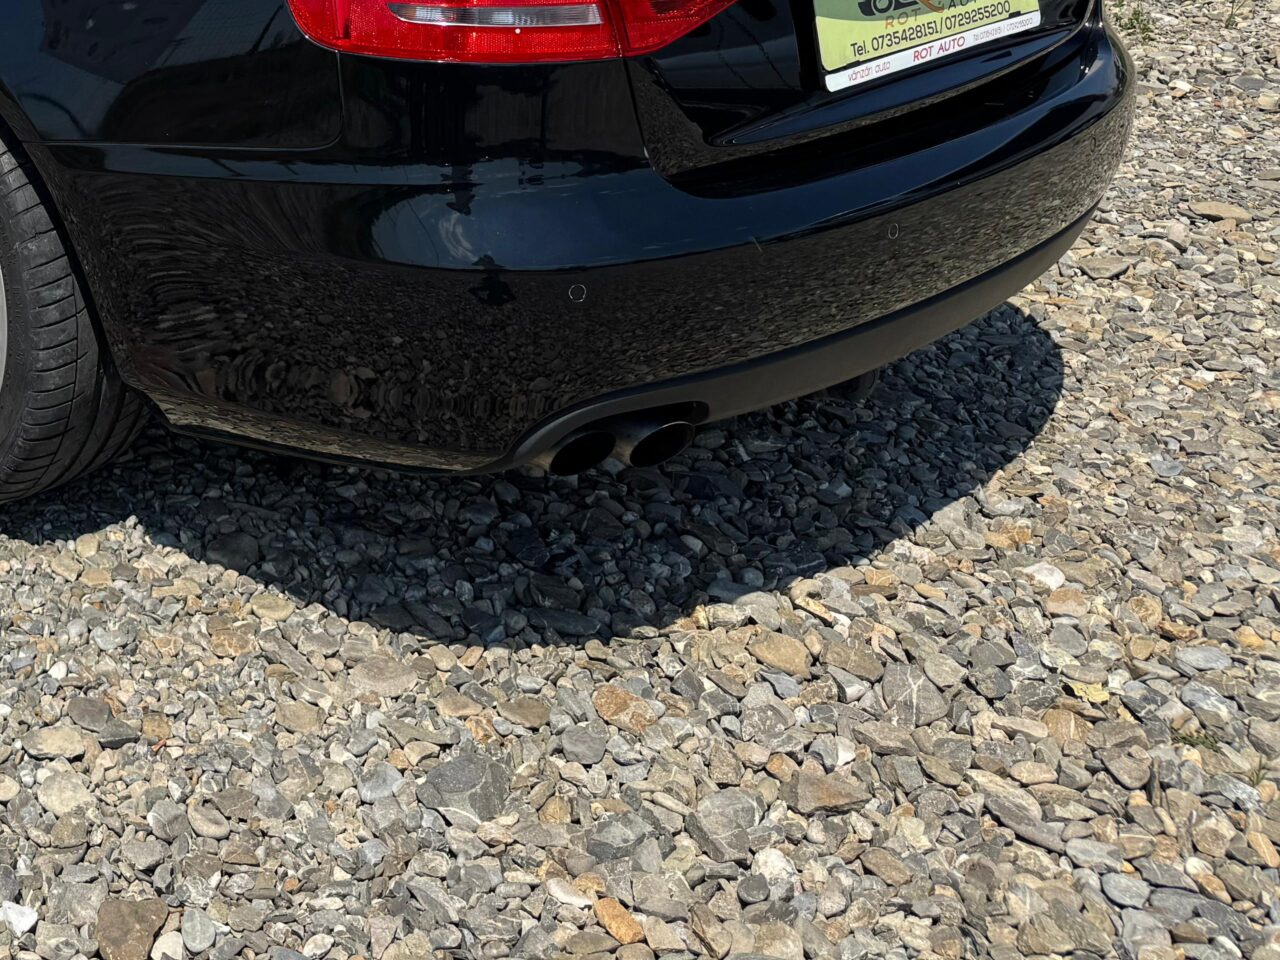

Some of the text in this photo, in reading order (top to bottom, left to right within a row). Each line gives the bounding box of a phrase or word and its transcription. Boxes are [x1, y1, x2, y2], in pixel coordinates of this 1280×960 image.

[884, 7, 920, 29] ROT
[850, 43, 870, 57] Tel.
[913, 36, 966, 62] ROT AUTO
